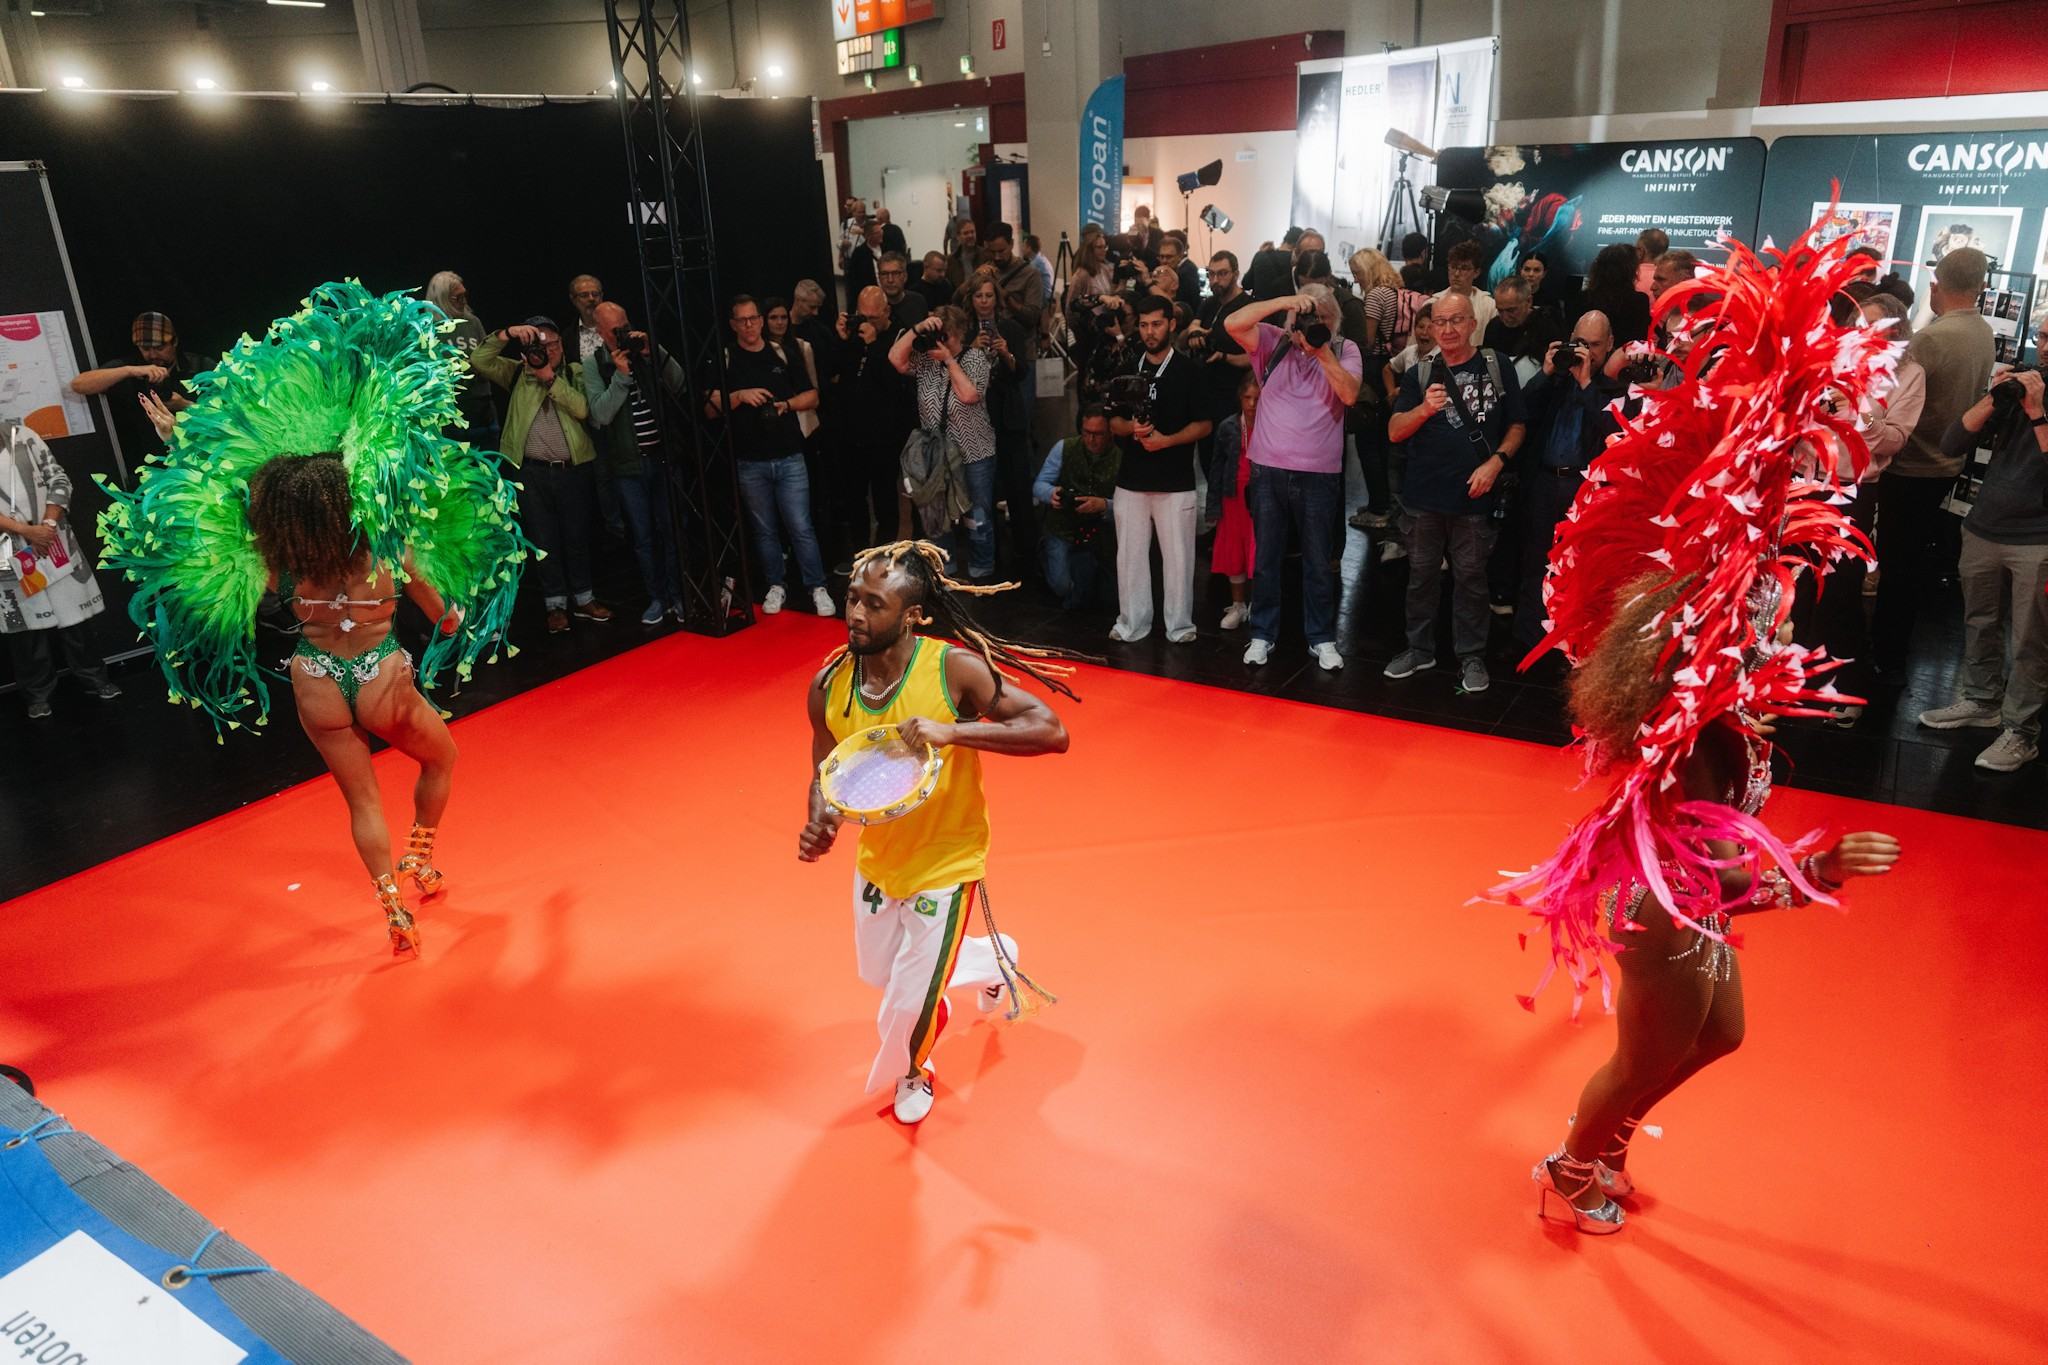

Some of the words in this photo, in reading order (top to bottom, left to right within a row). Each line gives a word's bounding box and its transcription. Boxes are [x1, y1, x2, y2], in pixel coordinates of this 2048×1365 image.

[1345, 84, 1381, 96] HEDLER
[1620, 146, 1726, 175] CANSON
[1644, 183, 1697, 192] INFINITY
[1938, 184, 2010, 195] INFINITY
[1599, 214, 1626, 224] JEDER
[1626, 214, 1651, 224] PRINT
[1652, 215, 1667, 224] EIN
[1667, 215, 1733, 225] MEISTERWERK
[1673, 227, 1733, 237] INKJETDRUCER
[862, 881, 883, 914] 4
